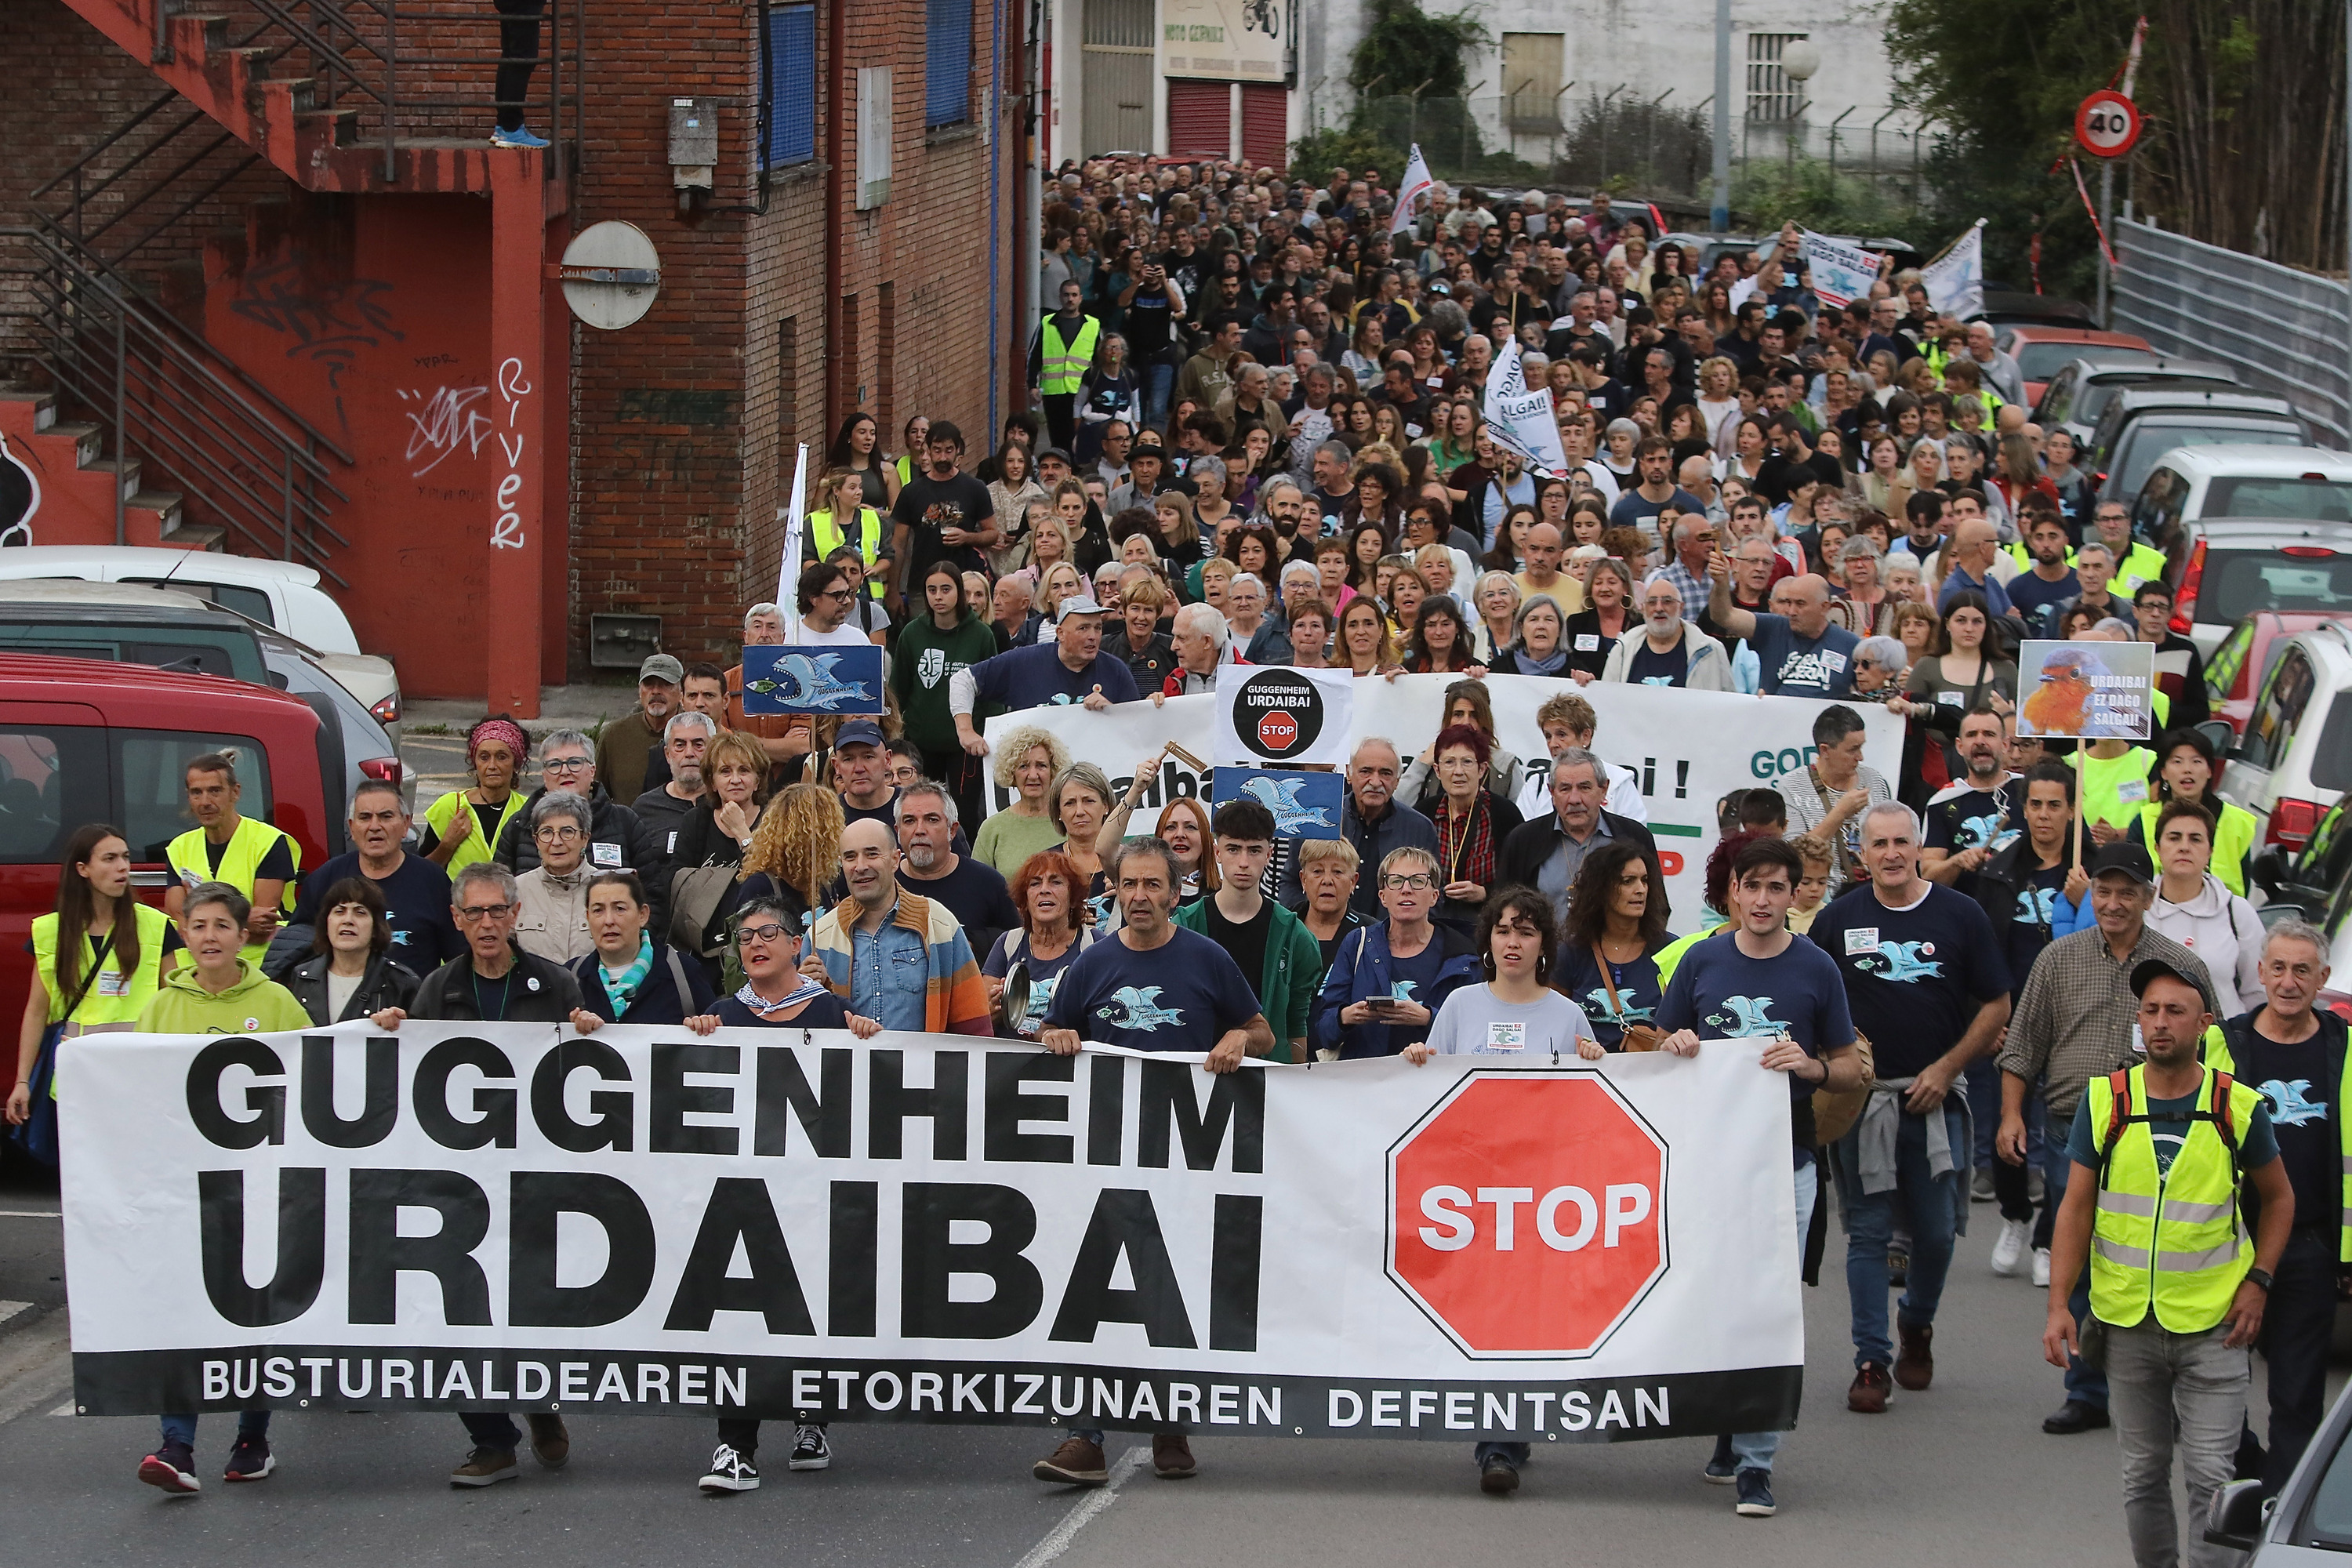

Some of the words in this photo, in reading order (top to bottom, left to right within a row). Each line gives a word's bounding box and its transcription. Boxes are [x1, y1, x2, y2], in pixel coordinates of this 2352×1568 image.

[2089, 114, 2125, 133] 40
[1247, 684, 1310, 695] GUGGENHEIM
[2089, 675, 2147, 689] URDAIBAI
[818, 685, 855, 695] GUGGENHEIM
[1247, 695, 1310, 707] URDAIBAI
[2094, 693, 2107, 706] EZ
[2108, 694, 2141, 708] DAGO
[2094, 712, 2140, 727] SALGAI!
[1261, 724, 1294, 735] STOP
[1280, 811, 1316, 819] GUGGENHEIM
[186, 1036, 1266, 1174] GUGGENHEIM
[1417, 1182, 1652, 1253] STOP
[198, 1167, 1264, 1353] URDAIBAI
[202, 1355, 747, 1409] BUSTURIALDEAREN
[792, 1370, 1283, 1428] ETORKIZUNAREN
[1328, 1385, 1671, 1432] DEFENTSAN
